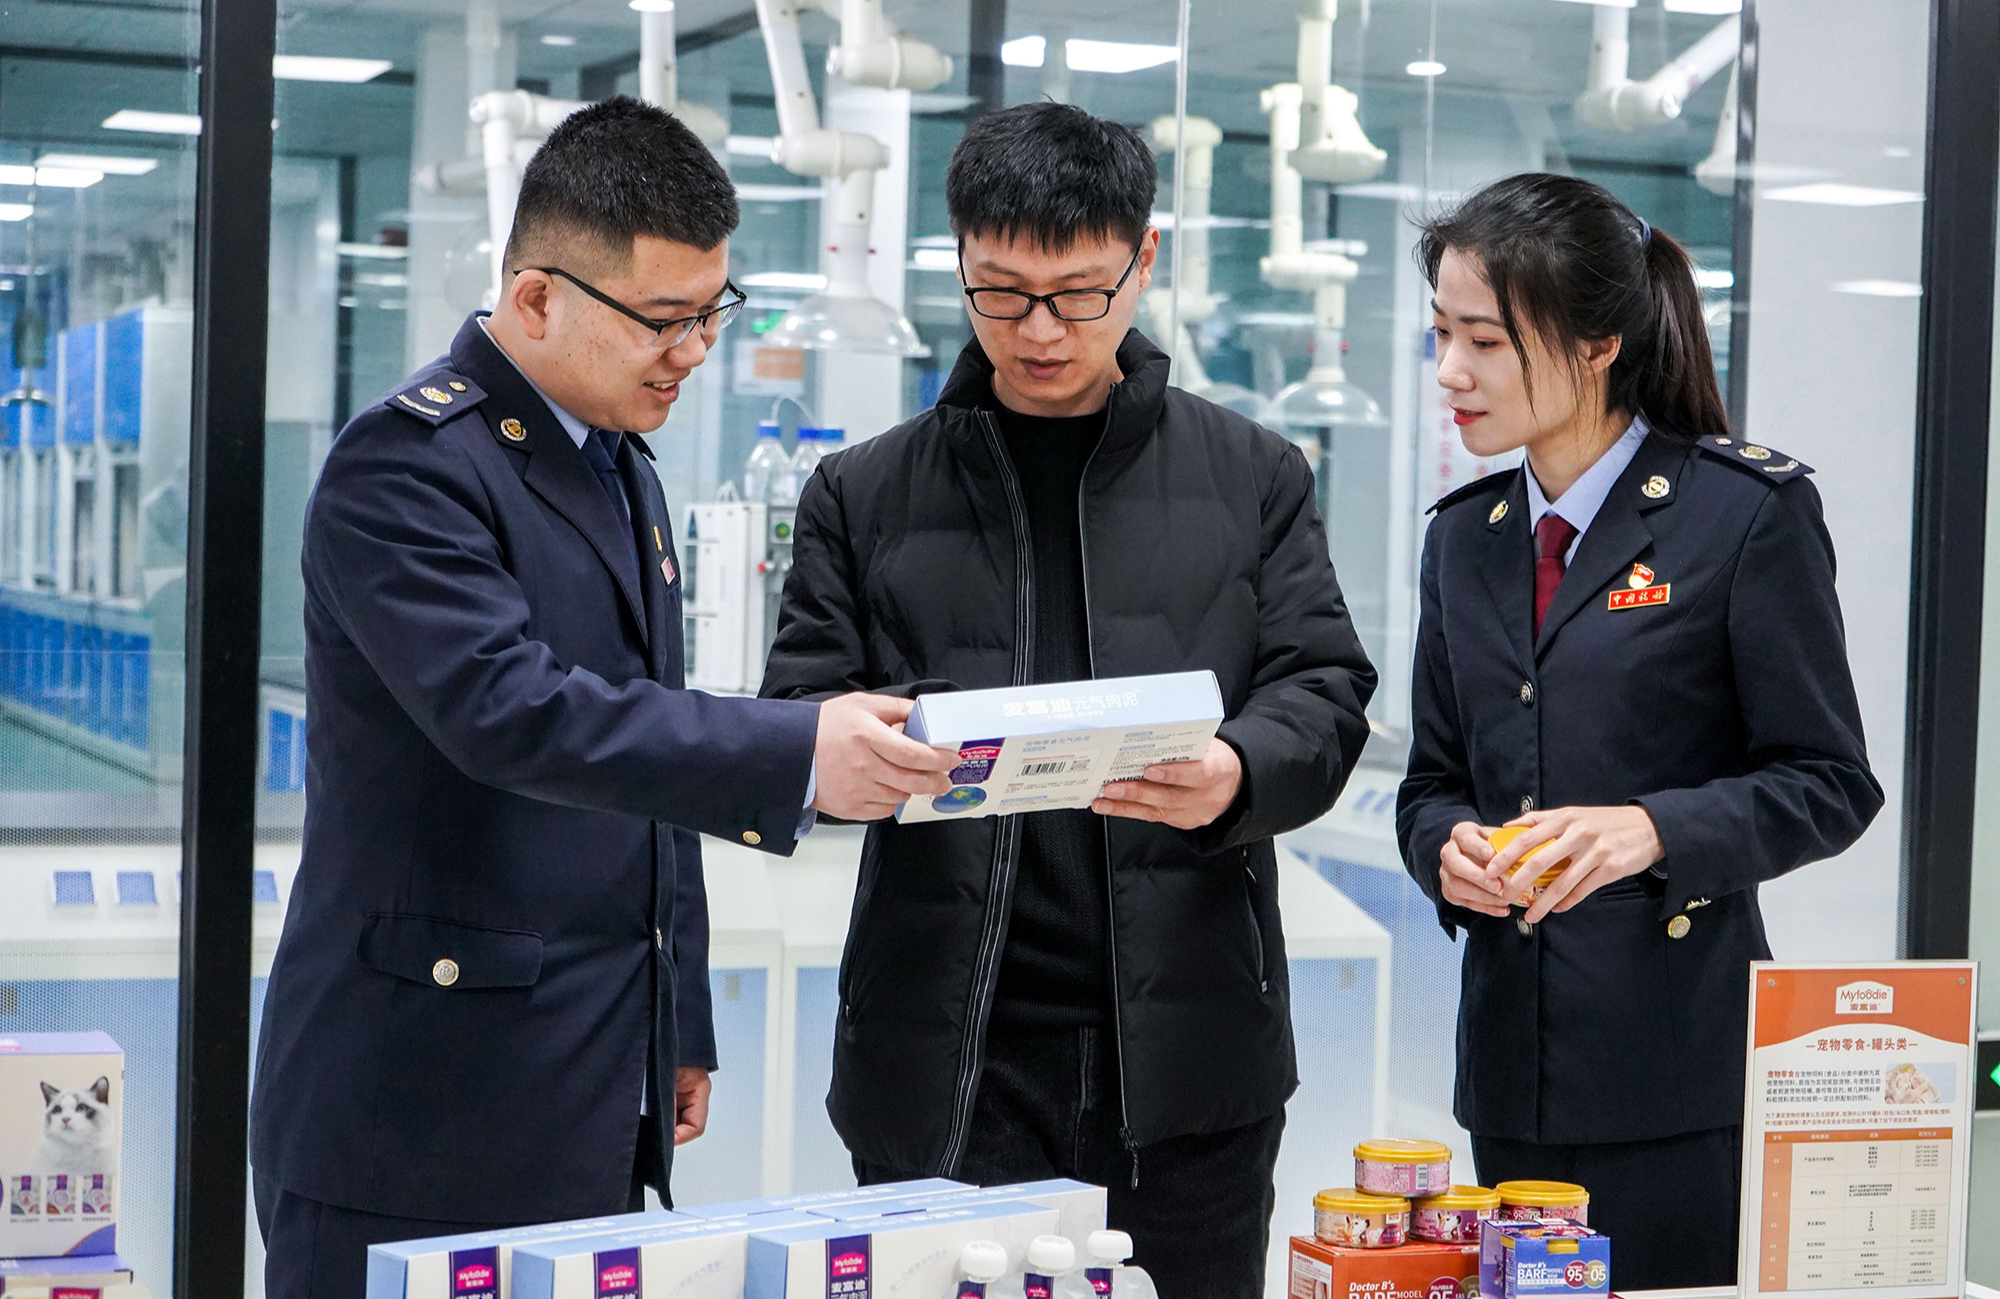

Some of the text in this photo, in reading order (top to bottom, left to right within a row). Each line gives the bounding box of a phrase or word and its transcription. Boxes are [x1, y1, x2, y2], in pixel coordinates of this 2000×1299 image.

[1840, 989, 1888, 1002] Myfoodie
[1518, 1269, 1547, 1279] BARF
[1567, 1269, 1583, 1281] 95
[1590, 1269, 1606, 1281] 05
[1349, 1281, 1395, 1292] Doctor B's
[1397, 1290, 1423, 1299] MODEL
